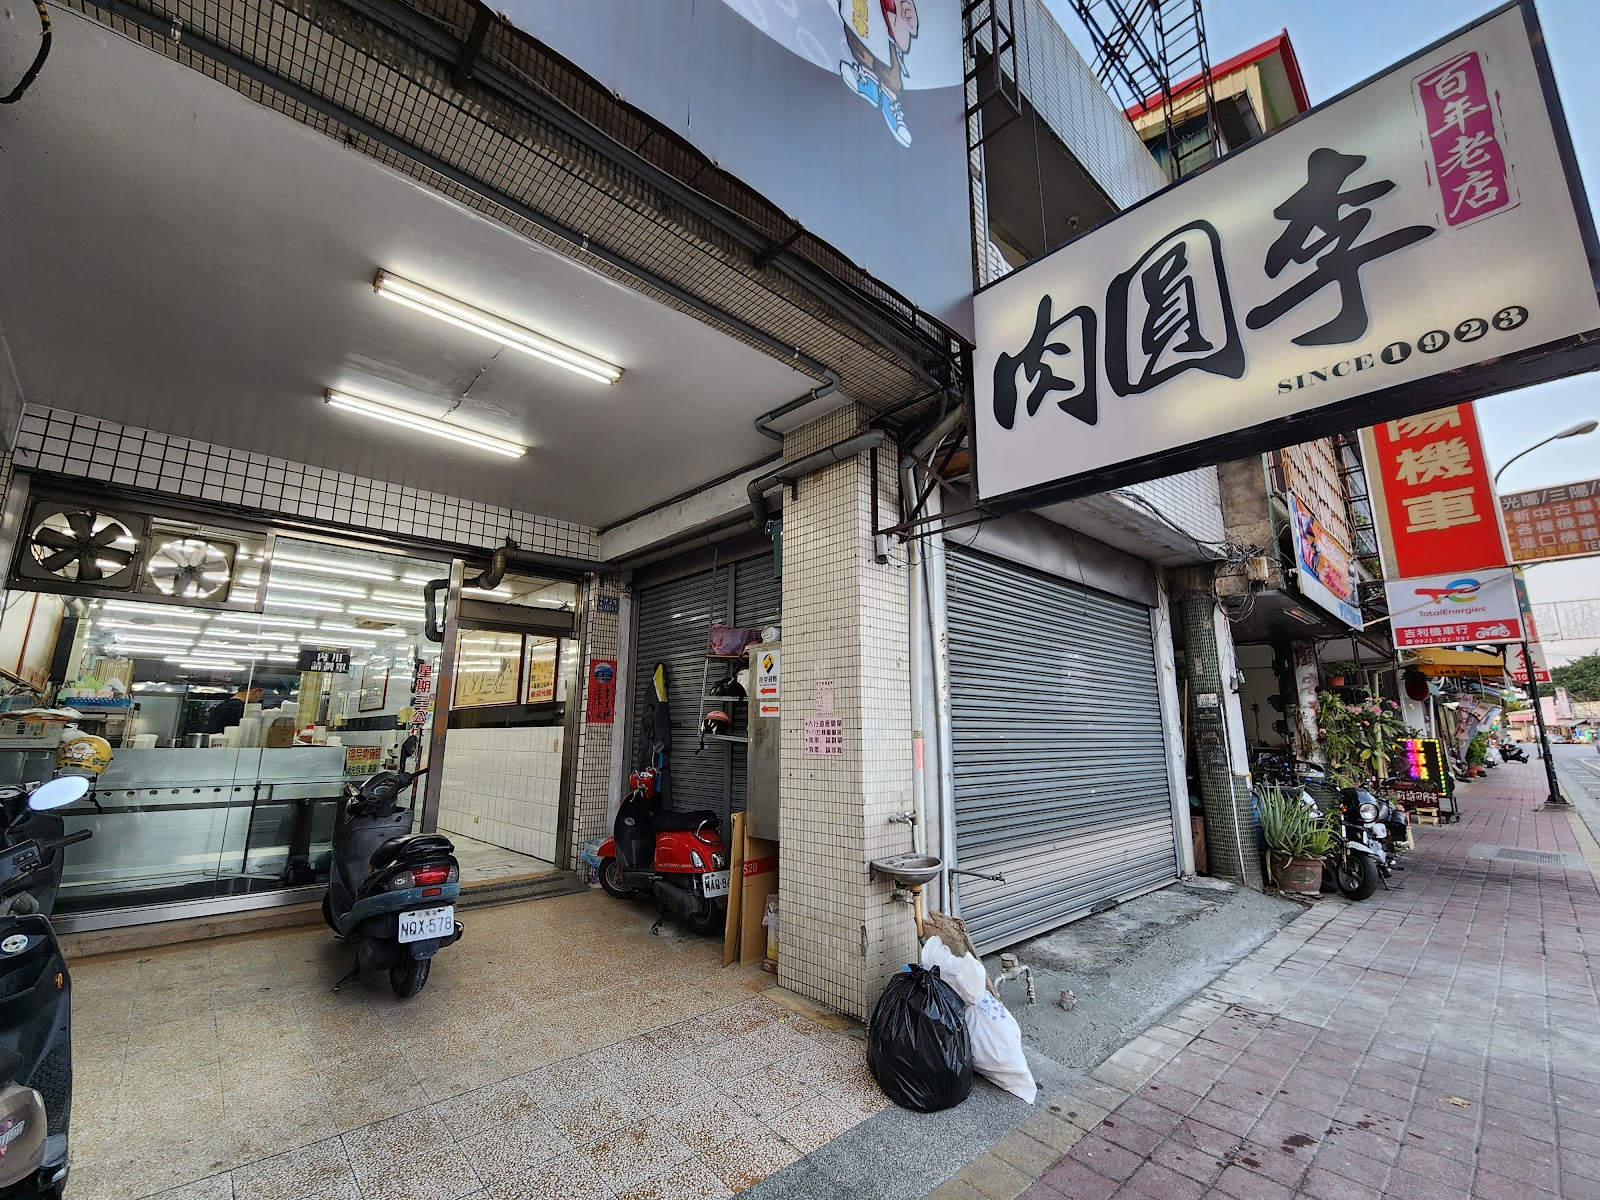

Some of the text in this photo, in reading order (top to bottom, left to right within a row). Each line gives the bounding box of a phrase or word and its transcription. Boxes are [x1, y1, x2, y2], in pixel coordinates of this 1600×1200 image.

[1422, 56, 1498, 218] 百年老店
[992, 147, 1438, 431] 肉圓李
[1278, 306, 1529, 395] SINCE 1923
[1502, 481, 1600, 511] 光陽/三陽/
[1516, 514, 1600, 536] 各種機車
[1418, 606, 1486, 617] TotalEnergies
[1403, 624, 1469, 639] 吉利機車行
[1414, 635, 1470, 644] 0921-302-997
[401, 916, 452, 937] NQX-578
